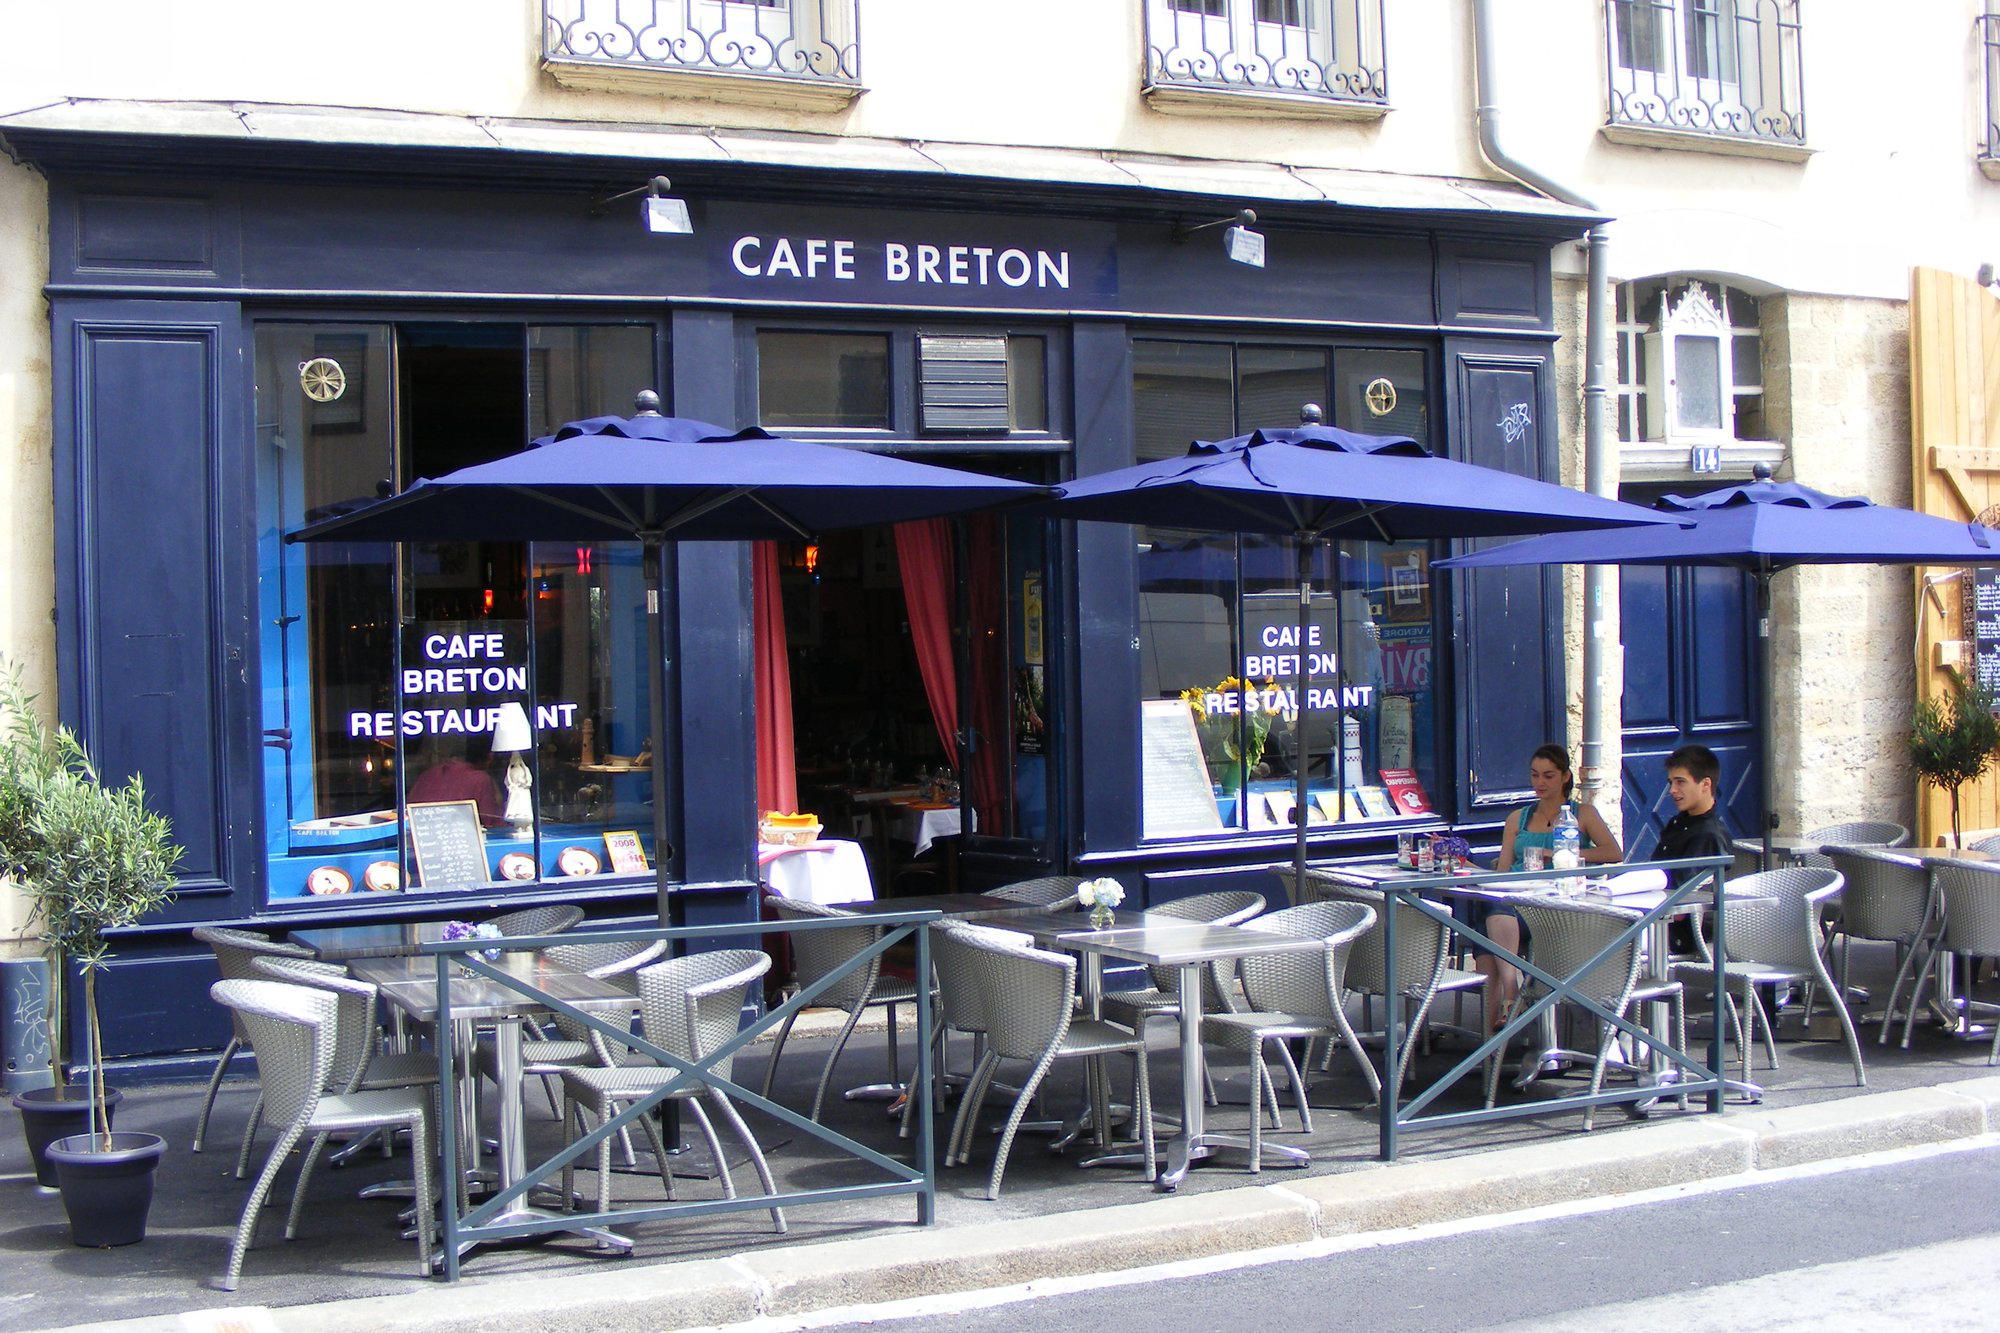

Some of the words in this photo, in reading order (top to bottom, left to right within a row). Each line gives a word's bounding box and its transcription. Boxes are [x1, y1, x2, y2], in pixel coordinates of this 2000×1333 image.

[732, 236, 856, 279] CAFE
[886, 243, 1070, 288] BRETON
[1699, 448, 1717, 469] 14
[426, 634, 504, 659] CAFE
[1246, 653, 1336, 676] BRETON
[403, 667, 527, 694] BRETON
[1206, 686, 1373, 714] RESTAURANT
[351, 704, 578, 736] RESTAURNT
[612, 839, 636, 847] 2008
